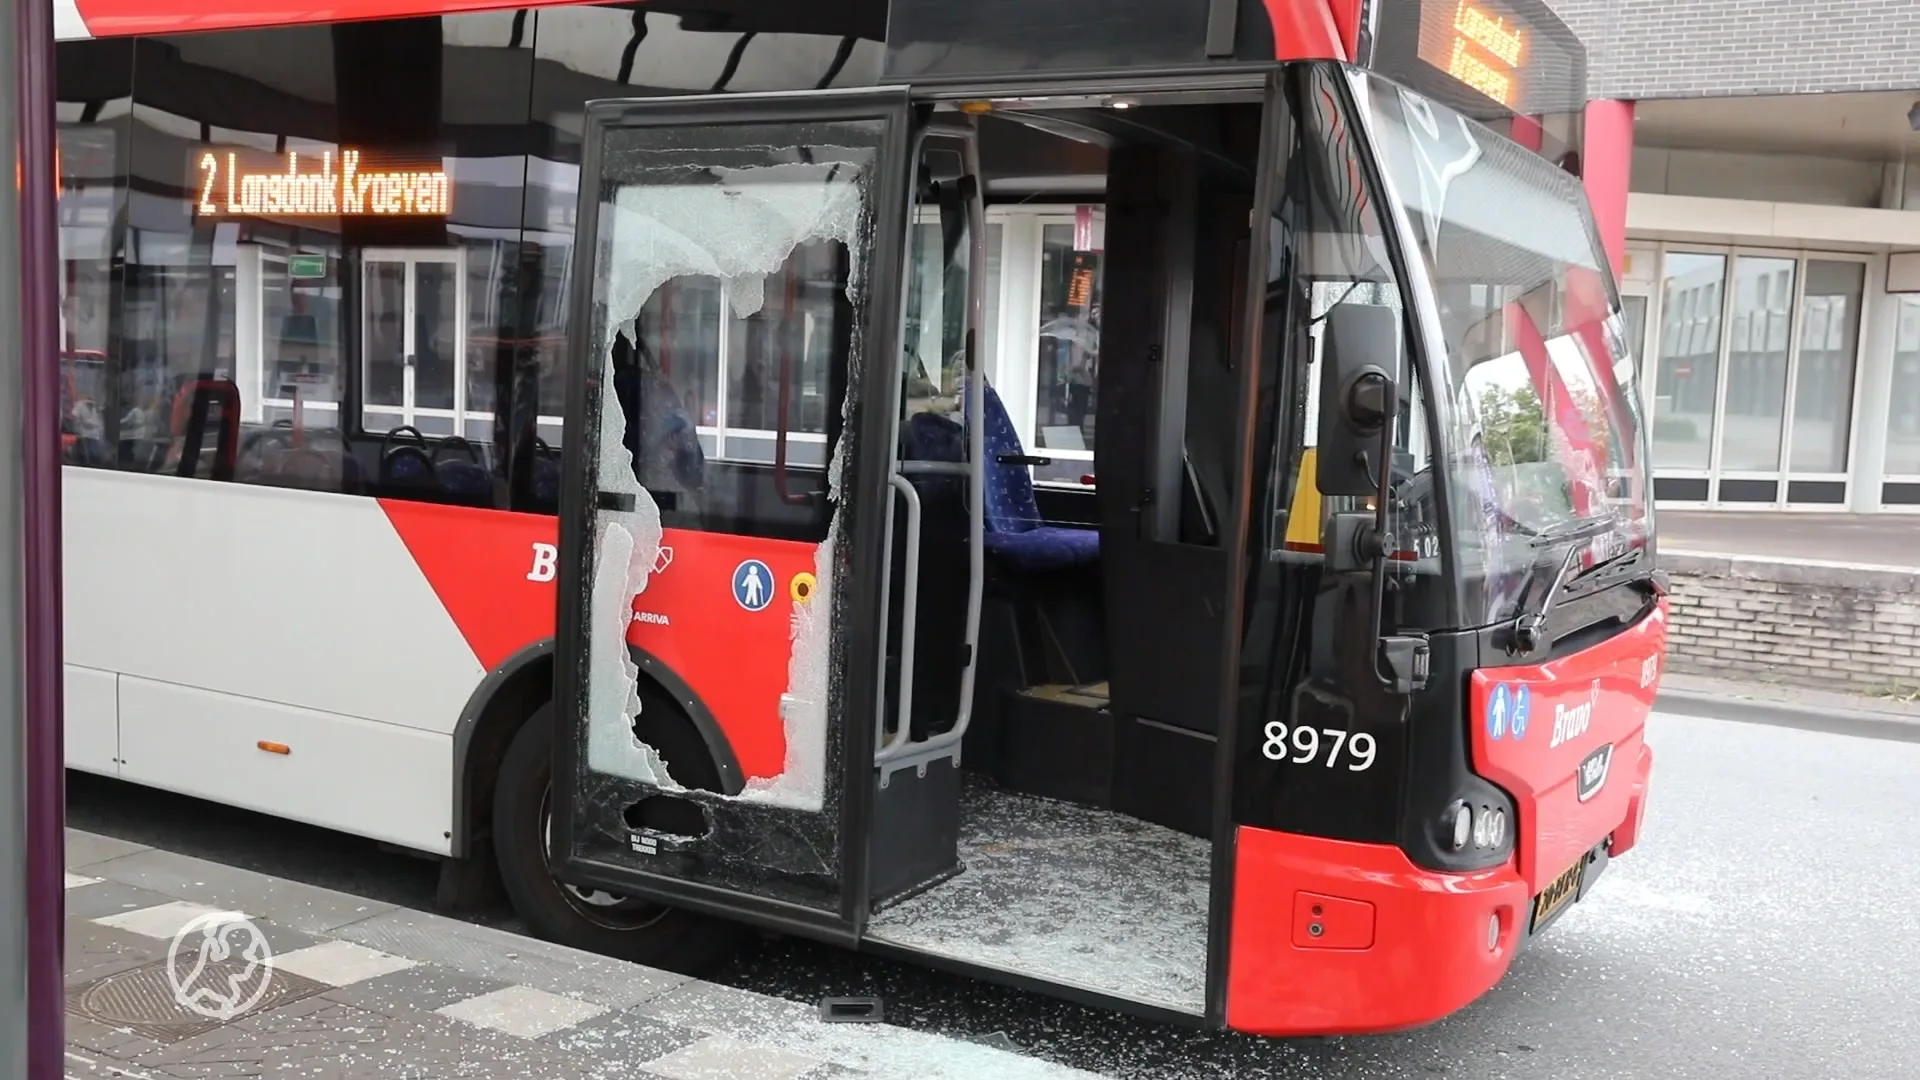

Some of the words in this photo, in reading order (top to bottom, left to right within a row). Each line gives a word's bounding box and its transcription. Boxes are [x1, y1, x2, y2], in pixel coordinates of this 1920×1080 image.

[199, 152, 217, 214] 2
[343, 150, 448, 213] Kroeven
[633, 611, 670, 626] ARRIVA
[1262, 721, 1377, 772] 8979
[1550, 700, 1591, 749] Bravo
